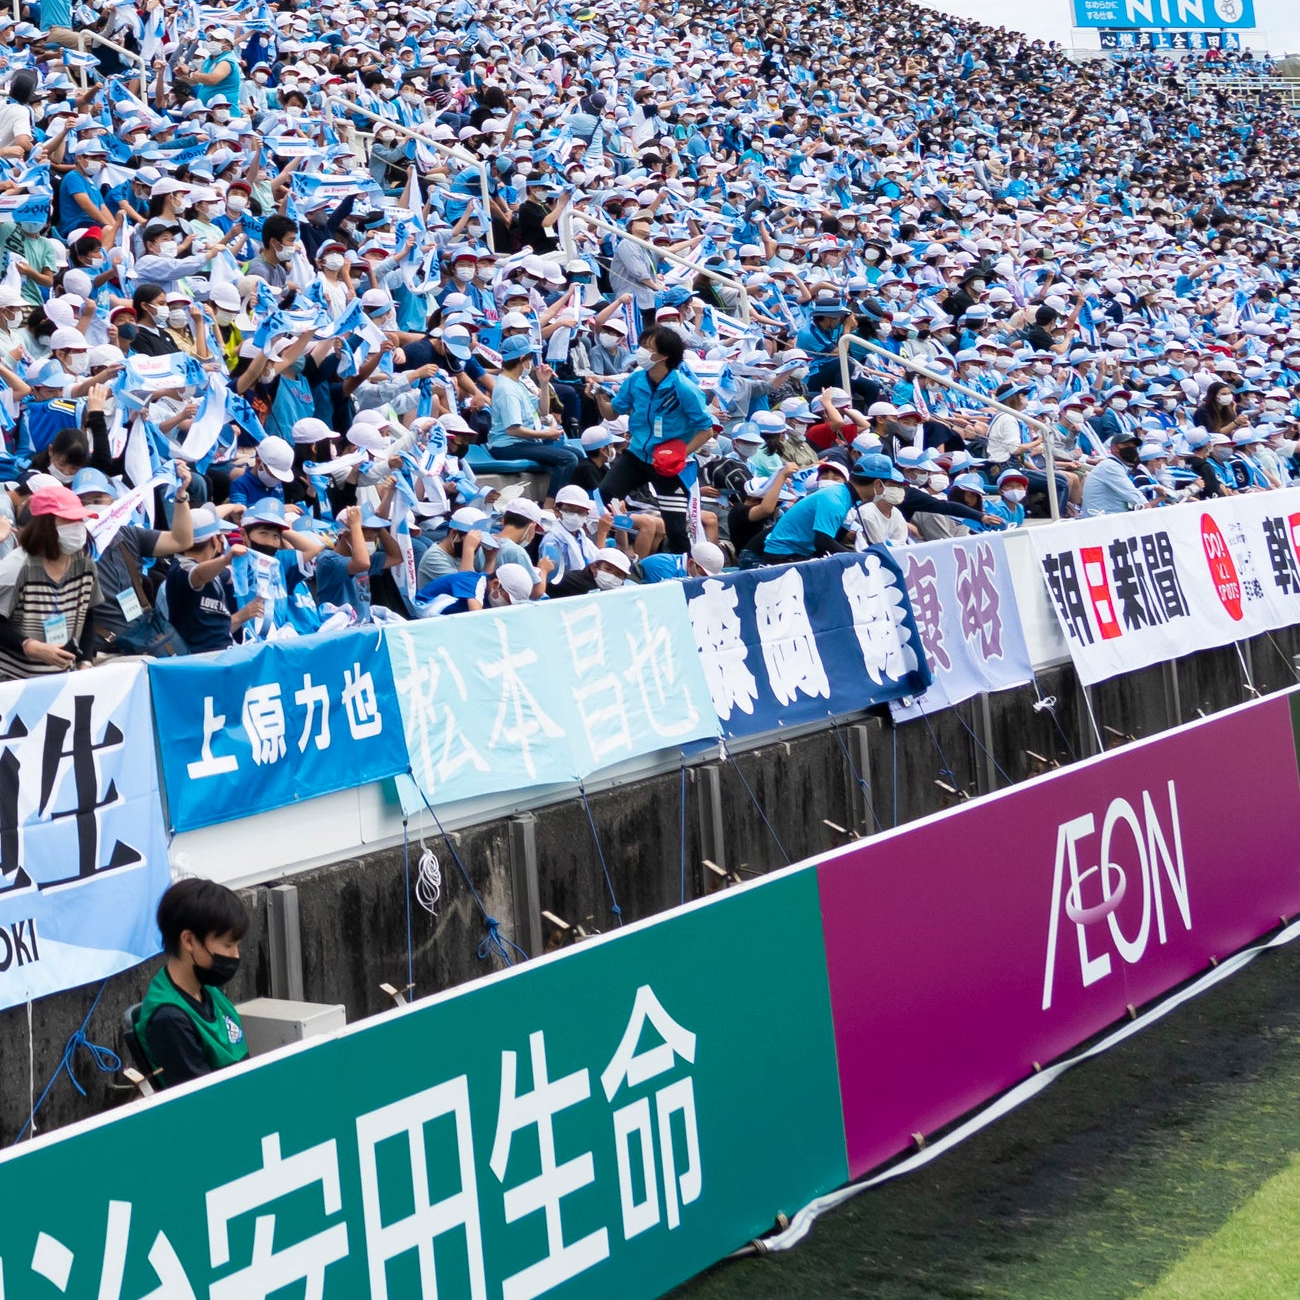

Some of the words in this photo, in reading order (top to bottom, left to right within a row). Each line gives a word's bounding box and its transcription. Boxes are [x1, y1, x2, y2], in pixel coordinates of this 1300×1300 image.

[1043, 531, 1190, 647] 朝日新聞
[1203, 531, 1226, 559] DO!
[200, 596, 220, 611] LOVE
[186, 661, 382, 780] 上原力也
[397, 599, 700, 796] 松本昌也
